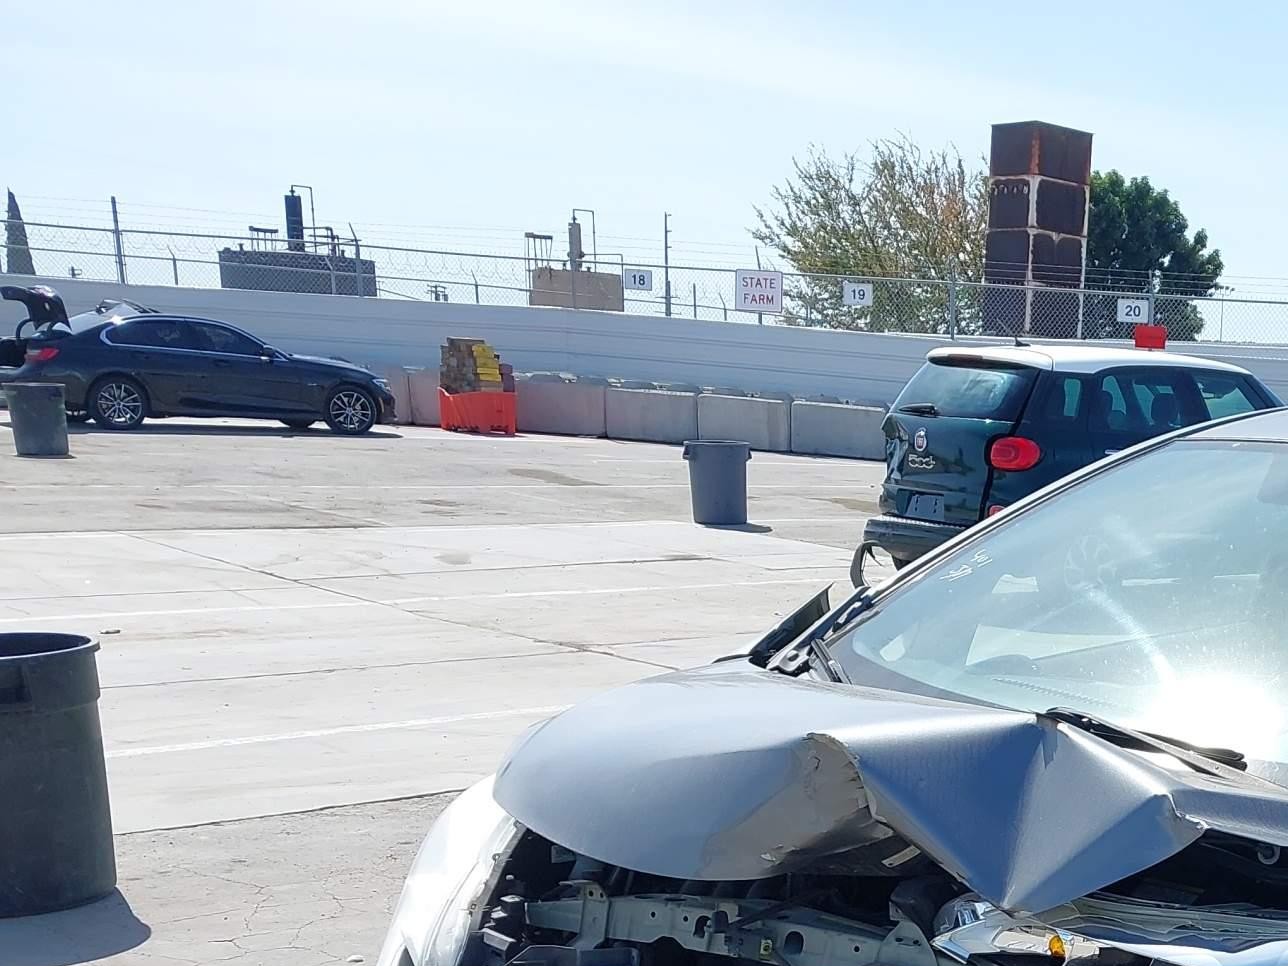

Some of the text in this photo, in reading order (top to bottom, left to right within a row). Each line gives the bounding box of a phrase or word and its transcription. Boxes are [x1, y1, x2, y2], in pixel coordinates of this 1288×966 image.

[632, 274, 646, 286] 18
[742, 277, 776, 289] STATE
[743, 293, 774, 305] FARM
[851, 288, 866, 300] 19
[1125, 305, 1141, 317] 20
